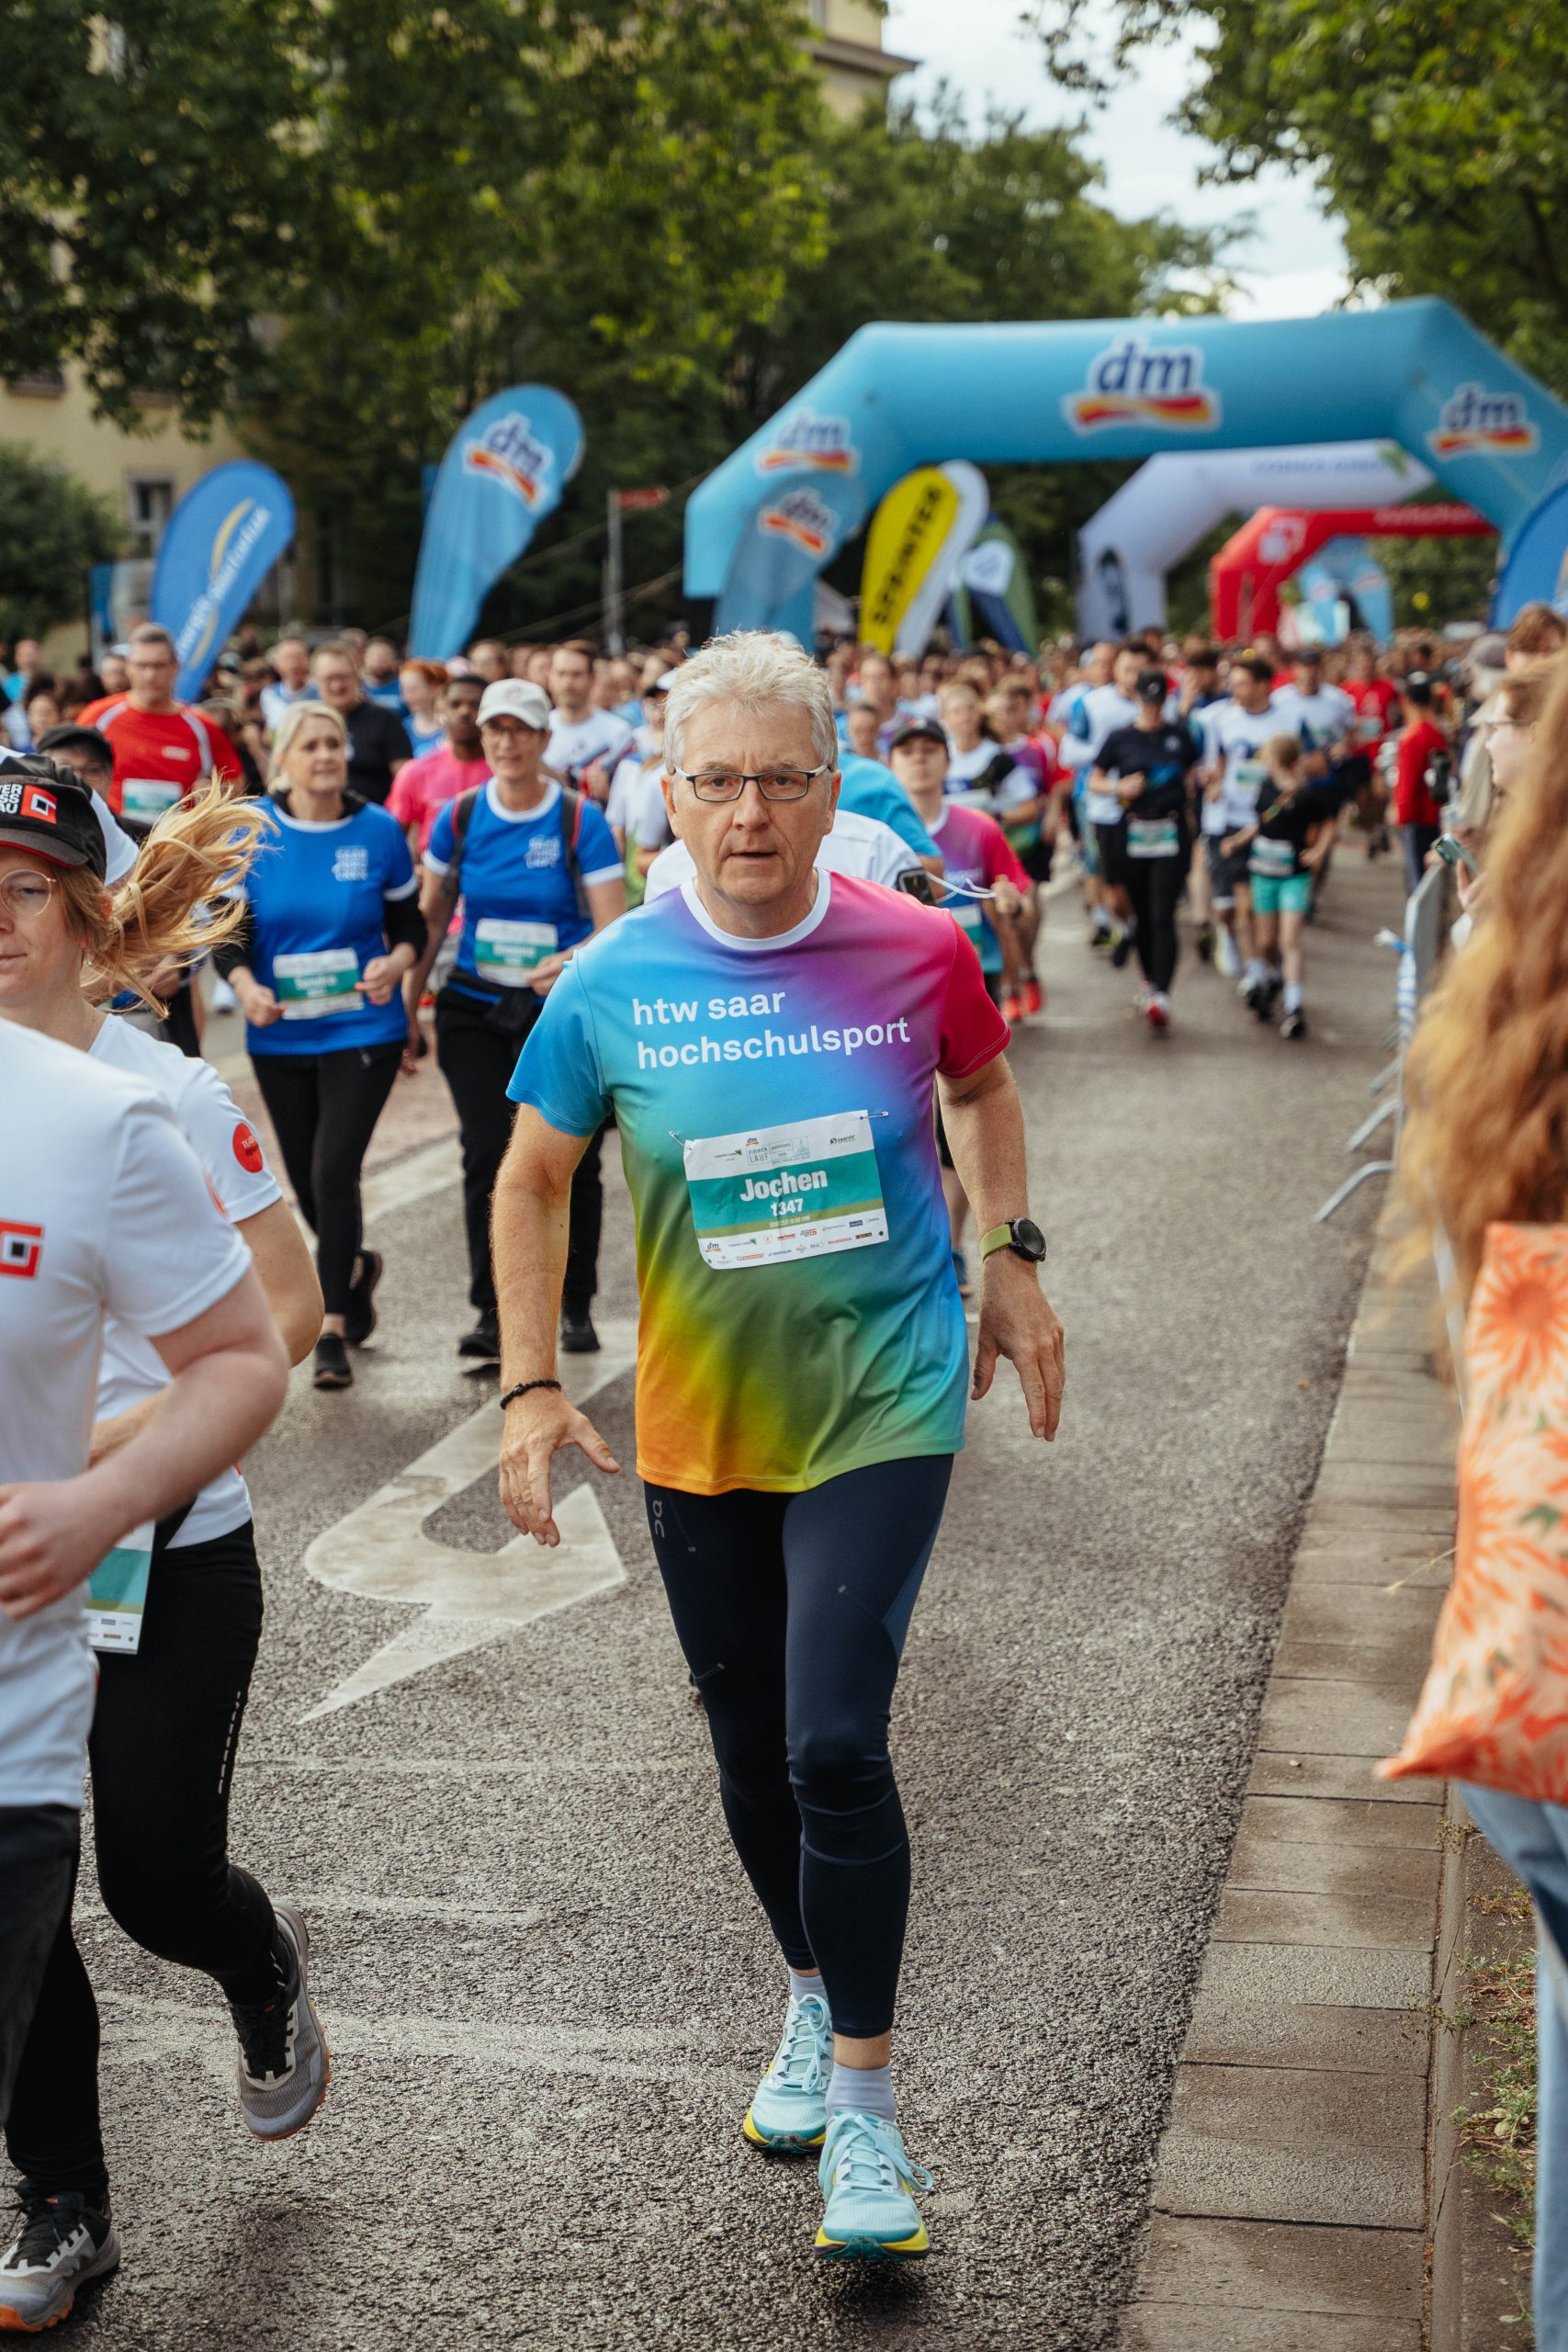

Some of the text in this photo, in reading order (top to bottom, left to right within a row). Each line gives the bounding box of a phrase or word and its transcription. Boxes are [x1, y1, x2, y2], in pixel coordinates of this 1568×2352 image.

[1096, 339, 1194, 394] dm
[1445, 386, 1522, 434] dm
[778, 412, 840, 449] dm
[632, 992, 785, 1025] htw saar
[637, 1017, 910, 1069] hochschulsport
[748, 1147, 768, 1155] FIRMEN
[749, 1153, 769, 1163] LAUF
[739, 1170, 828, 1202] Jochen
[770, 1198, 804, 1216] 1347
